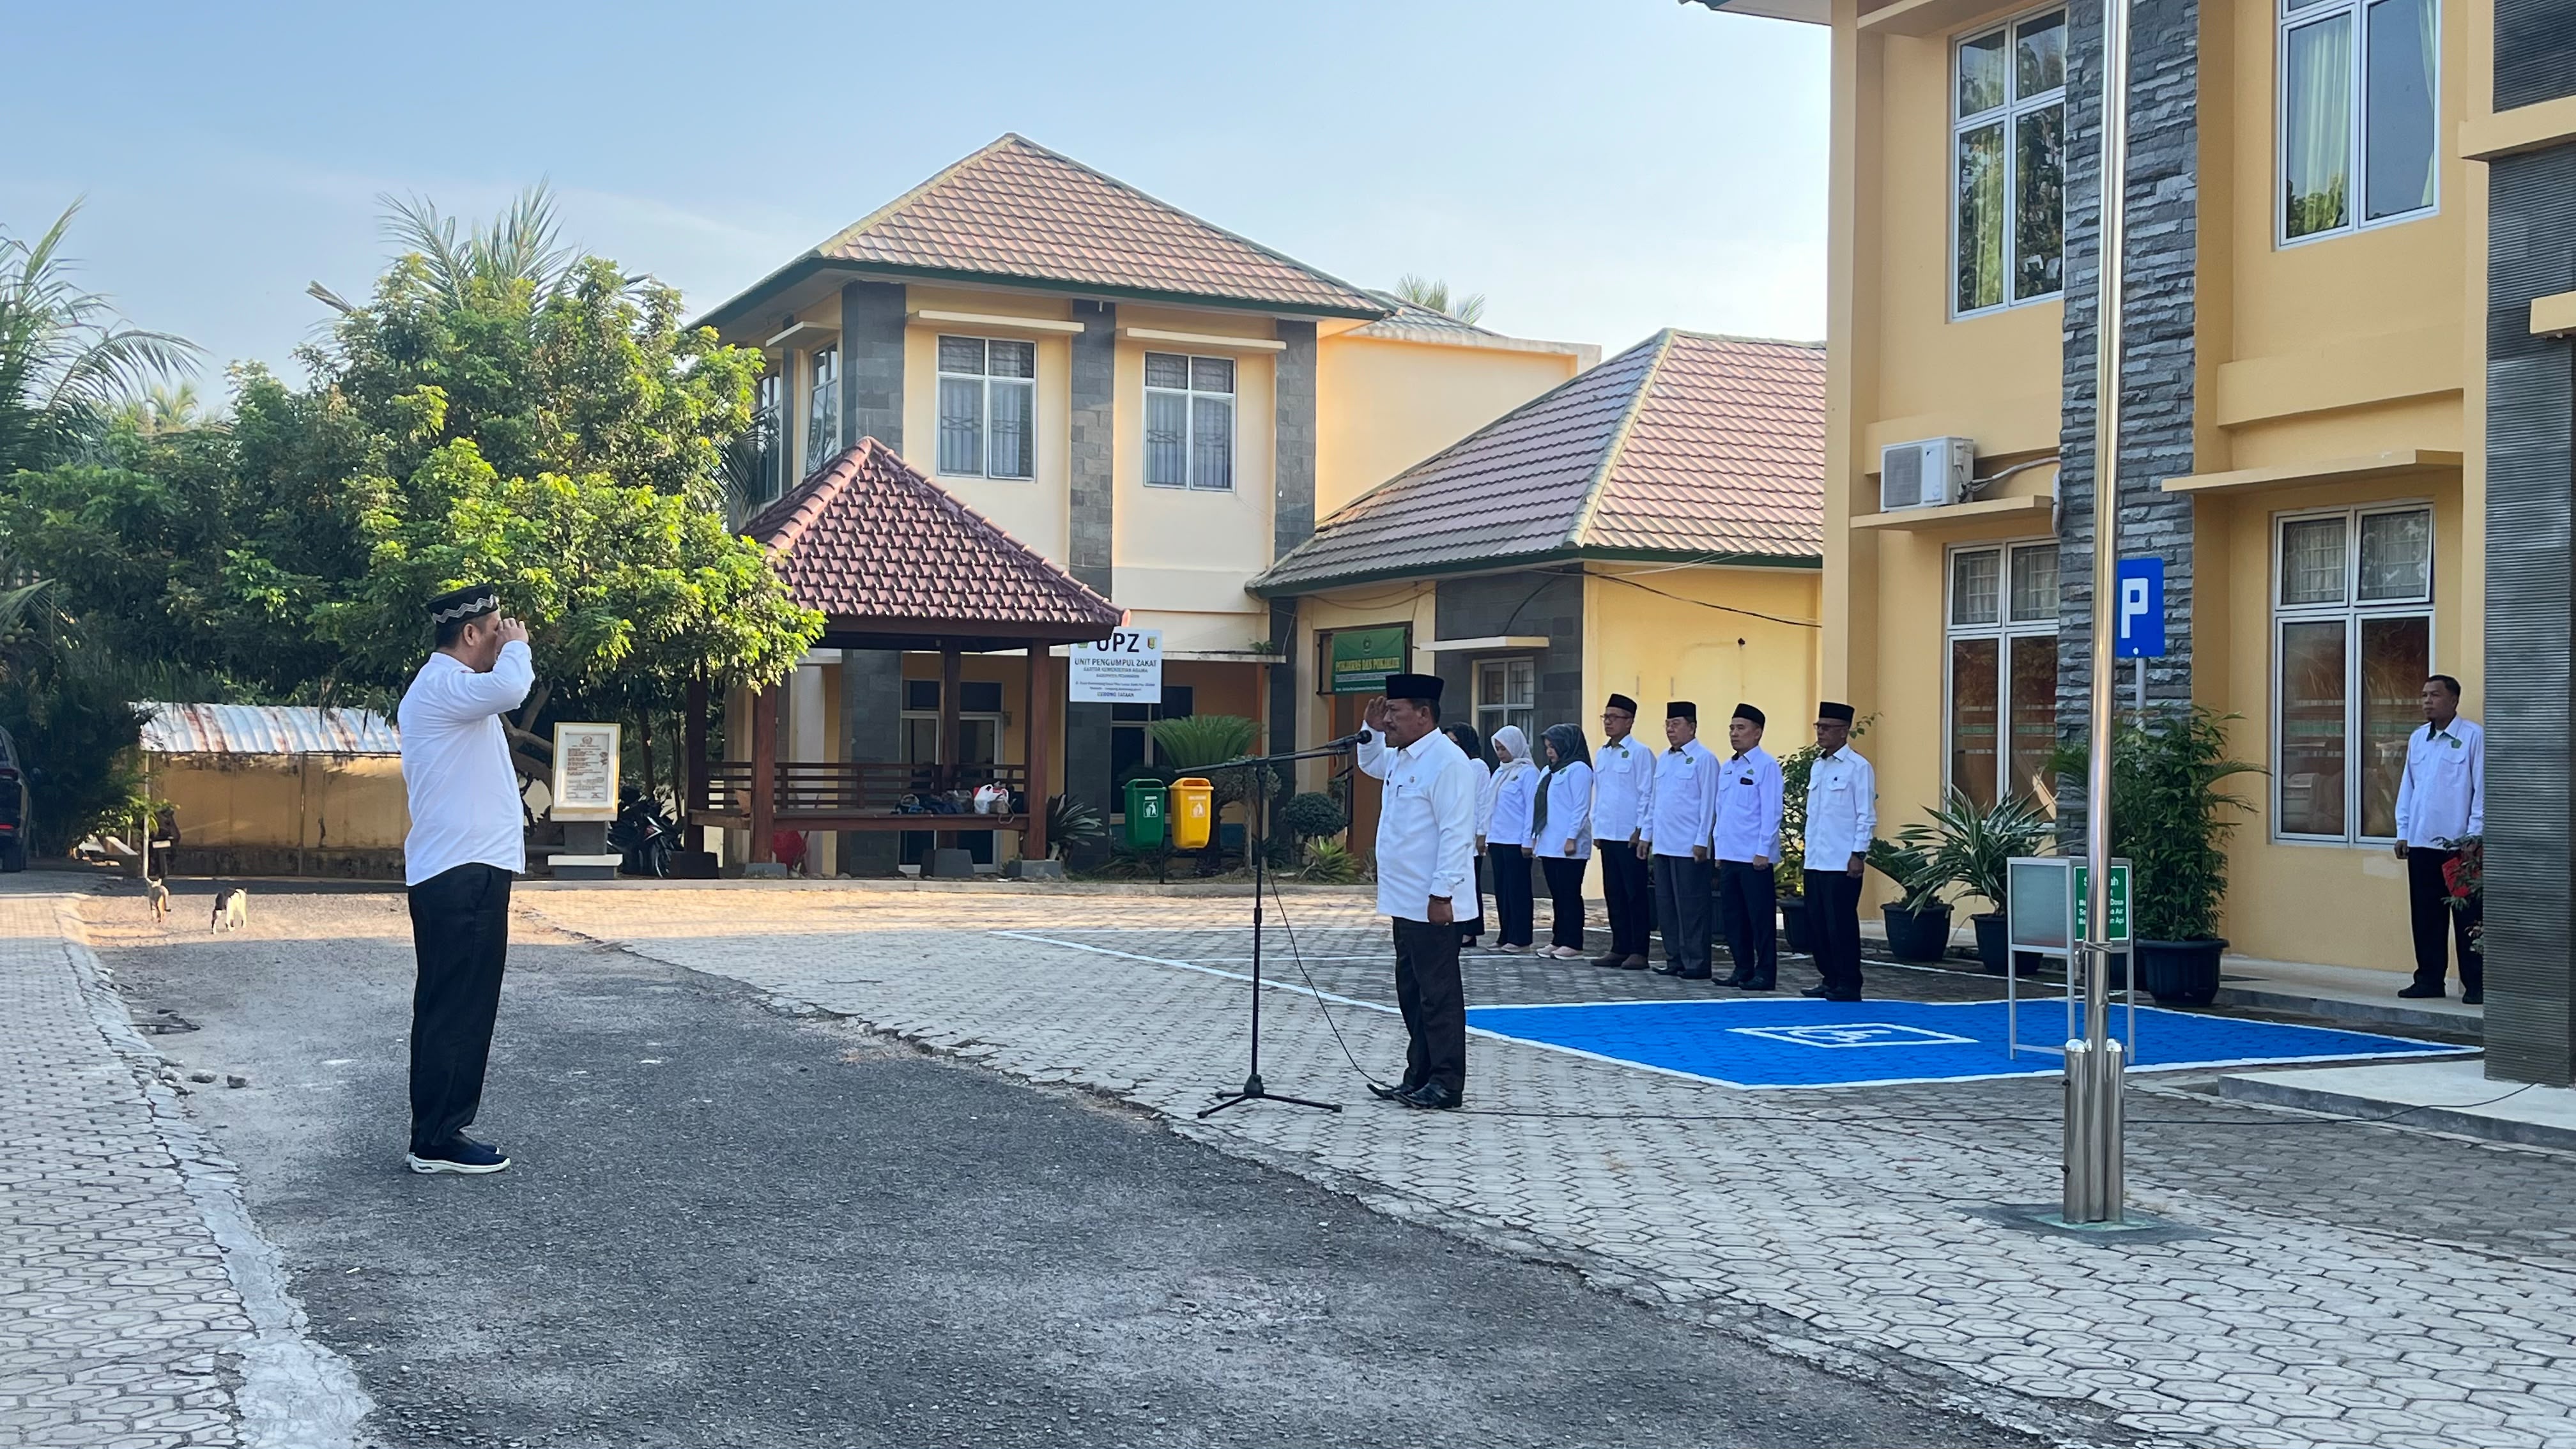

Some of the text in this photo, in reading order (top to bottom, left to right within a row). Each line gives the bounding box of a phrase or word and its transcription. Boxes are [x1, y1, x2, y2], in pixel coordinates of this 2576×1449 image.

[2121, 578, 2149, 639] P
[1097, 633, 1139, 652] UPZ
[1092, 658, 1135, 667] PENGUMPUL
[1136, 659, 1158, 668] ZAKAT
